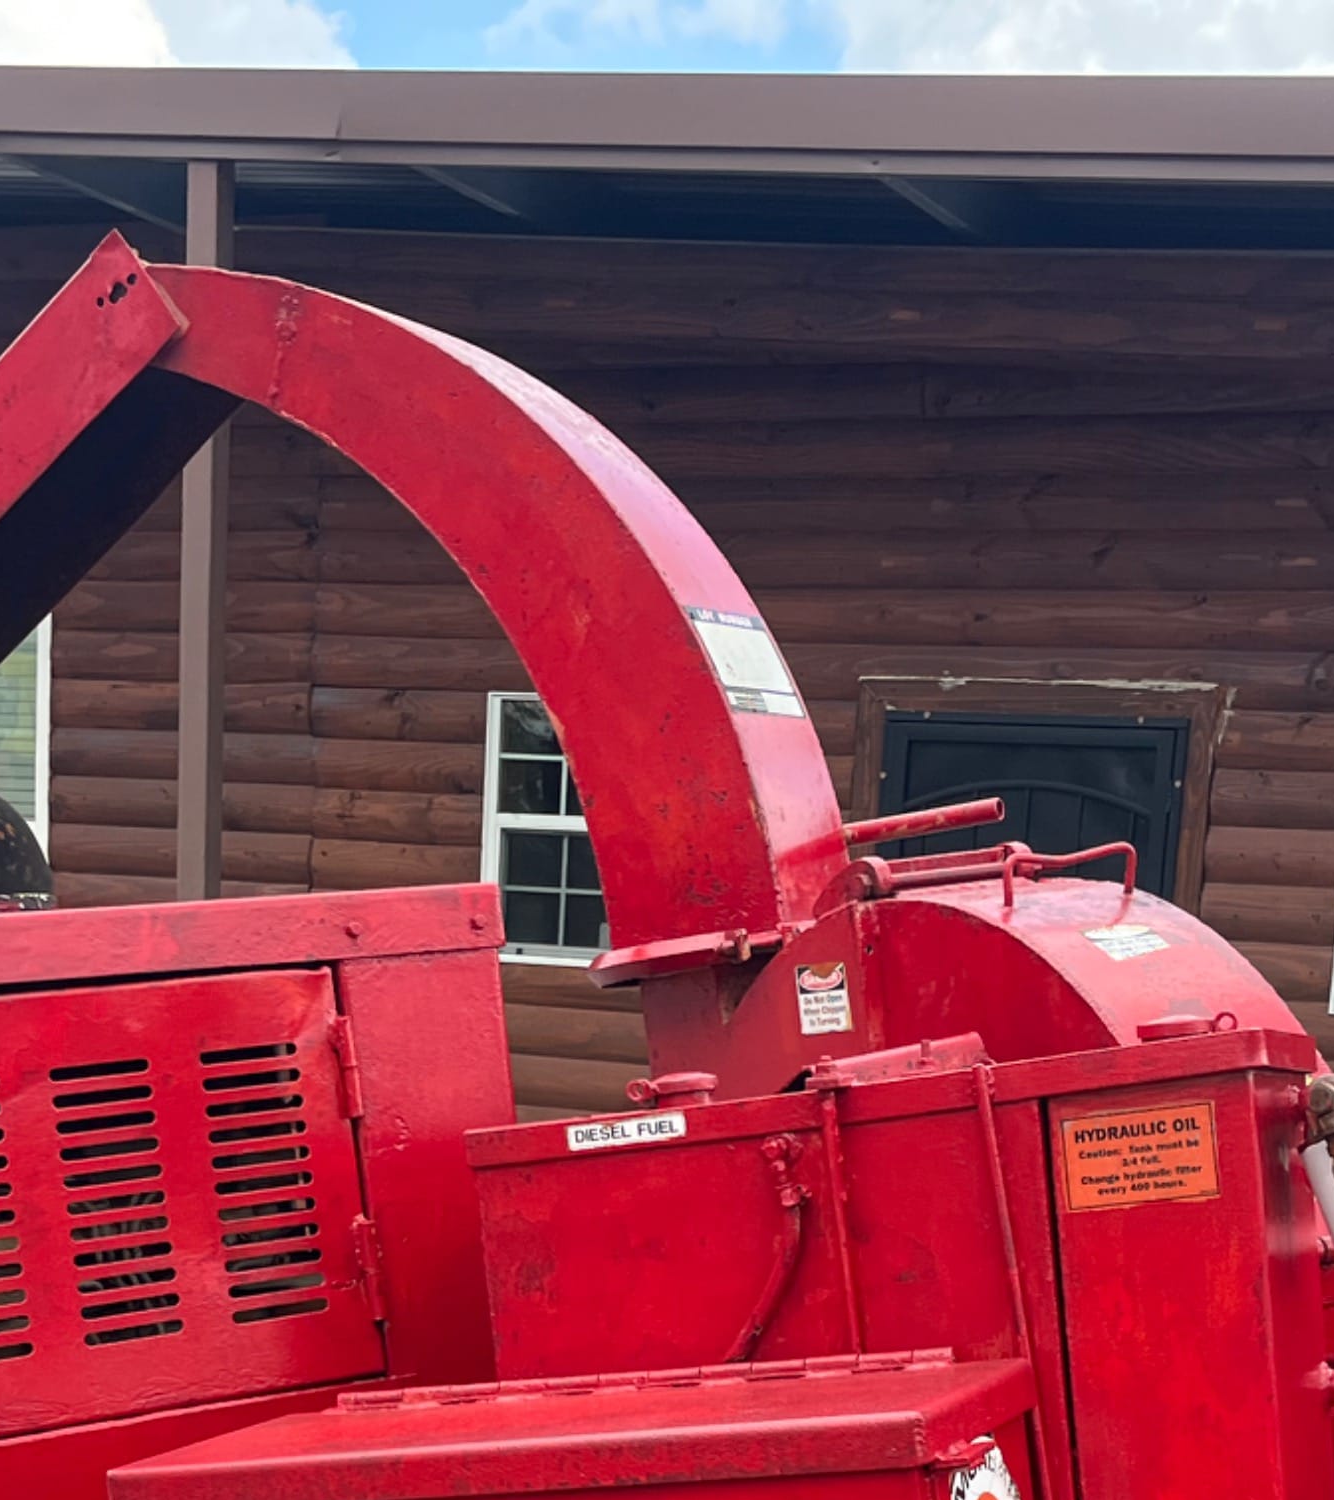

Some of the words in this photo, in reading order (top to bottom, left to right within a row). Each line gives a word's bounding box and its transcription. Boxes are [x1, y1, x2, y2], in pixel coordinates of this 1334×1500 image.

[575, 1124, 631, 1143] DIESEL
[637, 1120, 679, 1136] FUEL
[1075, 1120, 1167, 1144] HYDRAULIC
[1173, 1117, 1200, 1132] OIL
[1079, 1148, 1121, 1159] Caution:
[1157, 1139, 1183, 1150] must
[1187, 1139, 1199, 1147] be
[1141, 1155, 1161, 1165] full.
[1081, 1173, 1119, 1185] Change
[1123, 1168, 1172, 1182] hydraulic
[1175, 1165, 1202, 1174] filter
[1097, 1185, 1127, 1195] every
[1130, 1181, 1150, 1192] 400
[1154, 1180, 1187, 1189] hours.
